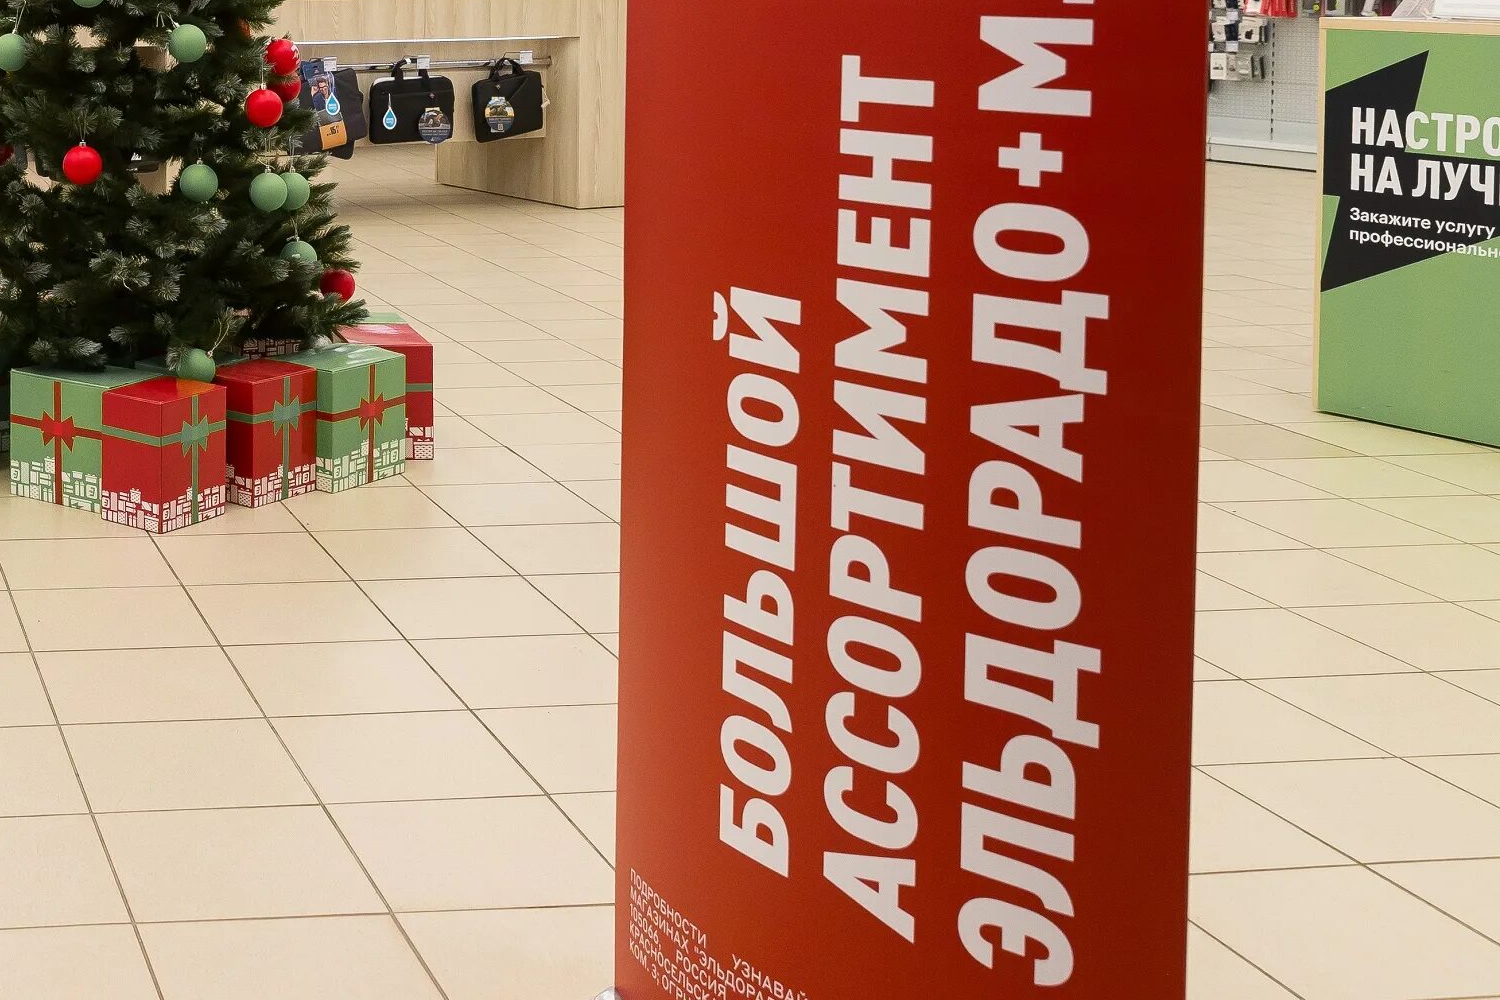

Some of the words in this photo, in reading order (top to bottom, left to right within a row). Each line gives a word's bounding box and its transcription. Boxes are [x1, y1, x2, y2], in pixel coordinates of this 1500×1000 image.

[1350, 152, 1403, 196] НА
[1411, 159, 1500, 206] ЛУЧ
[1350, 207, 1431, 229] Закажите
[1435, 219, 1496, 239] услугу
[823, 55, 935, 944] АССОРТИМЕНТ
[712, 286, 802, 877] БОЛЬШОЙ
[629, 867, 707, 949] ПОДРОБНОСТИ
[629, 886, 690, 954] МАГАЗИНАХ
[628, 937, 649, 972] КОМ.
[675, 949, 726, 1000] РОССИЯ
